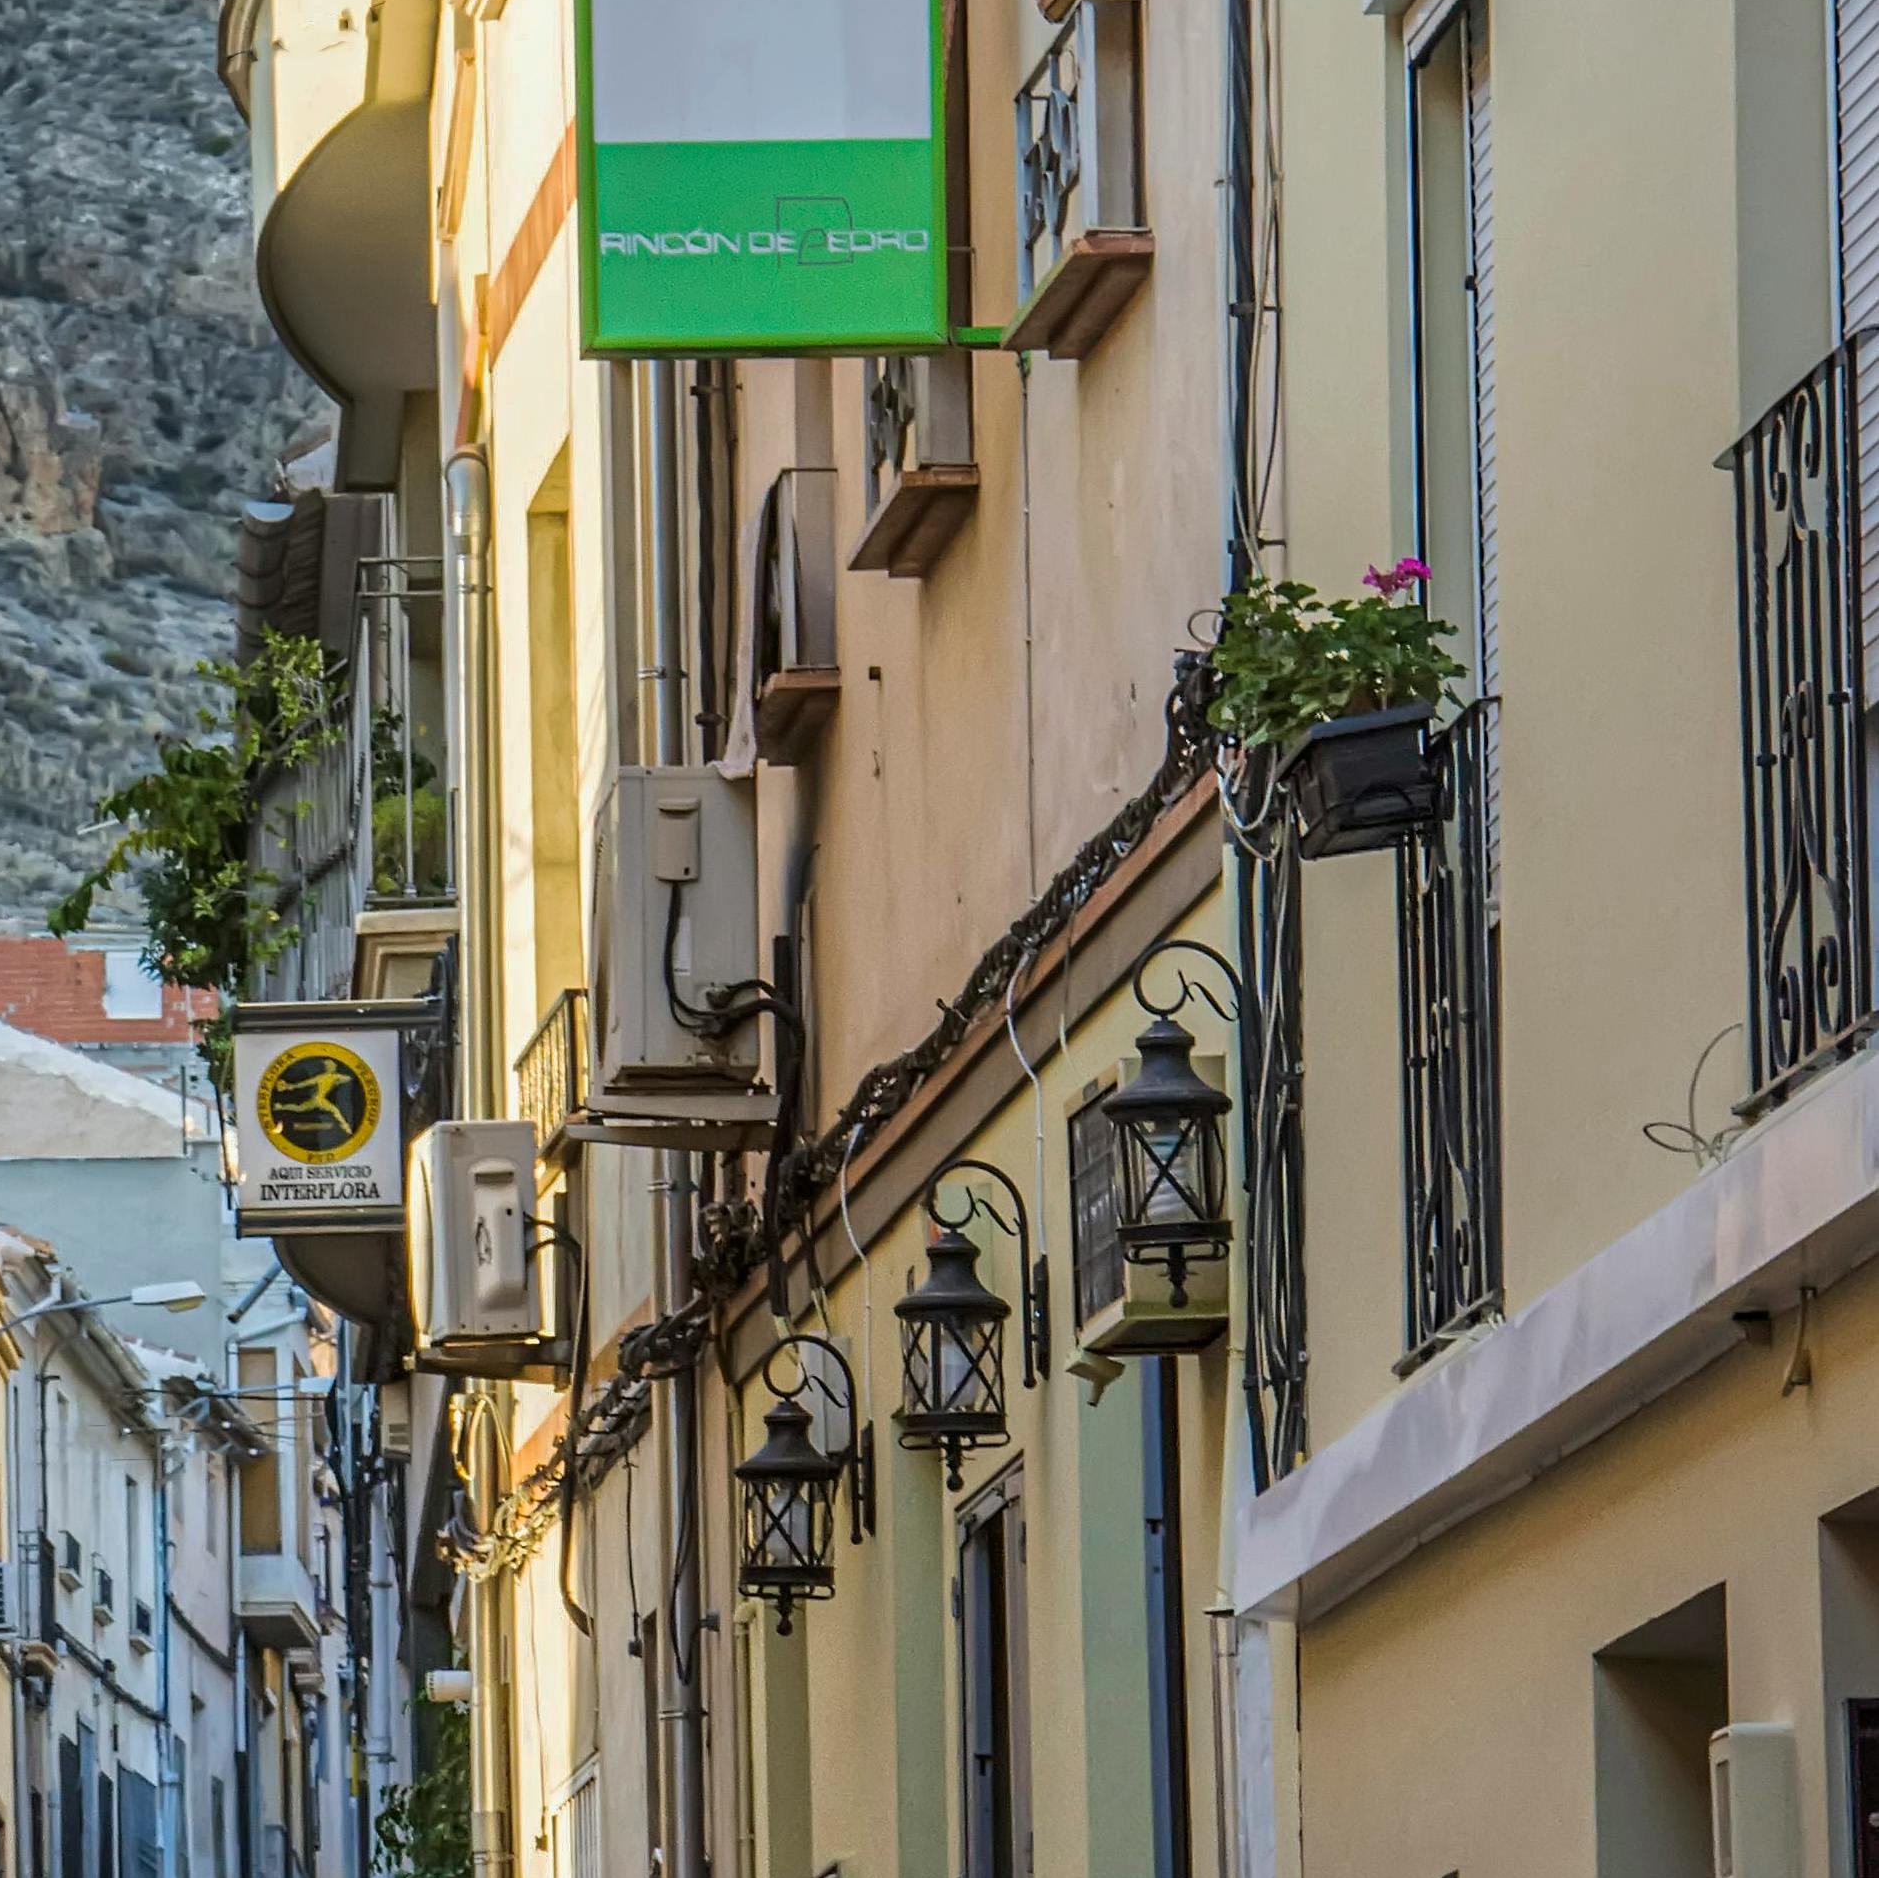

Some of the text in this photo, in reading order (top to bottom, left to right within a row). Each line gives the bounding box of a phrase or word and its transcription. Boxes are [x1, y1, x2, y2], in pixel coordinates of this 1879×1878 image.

[748, 230, 798, 255] DE
[307, 1164, 372, 1181] SERVICIO
[260, 1182, 381, 1201] INTERFLORA
